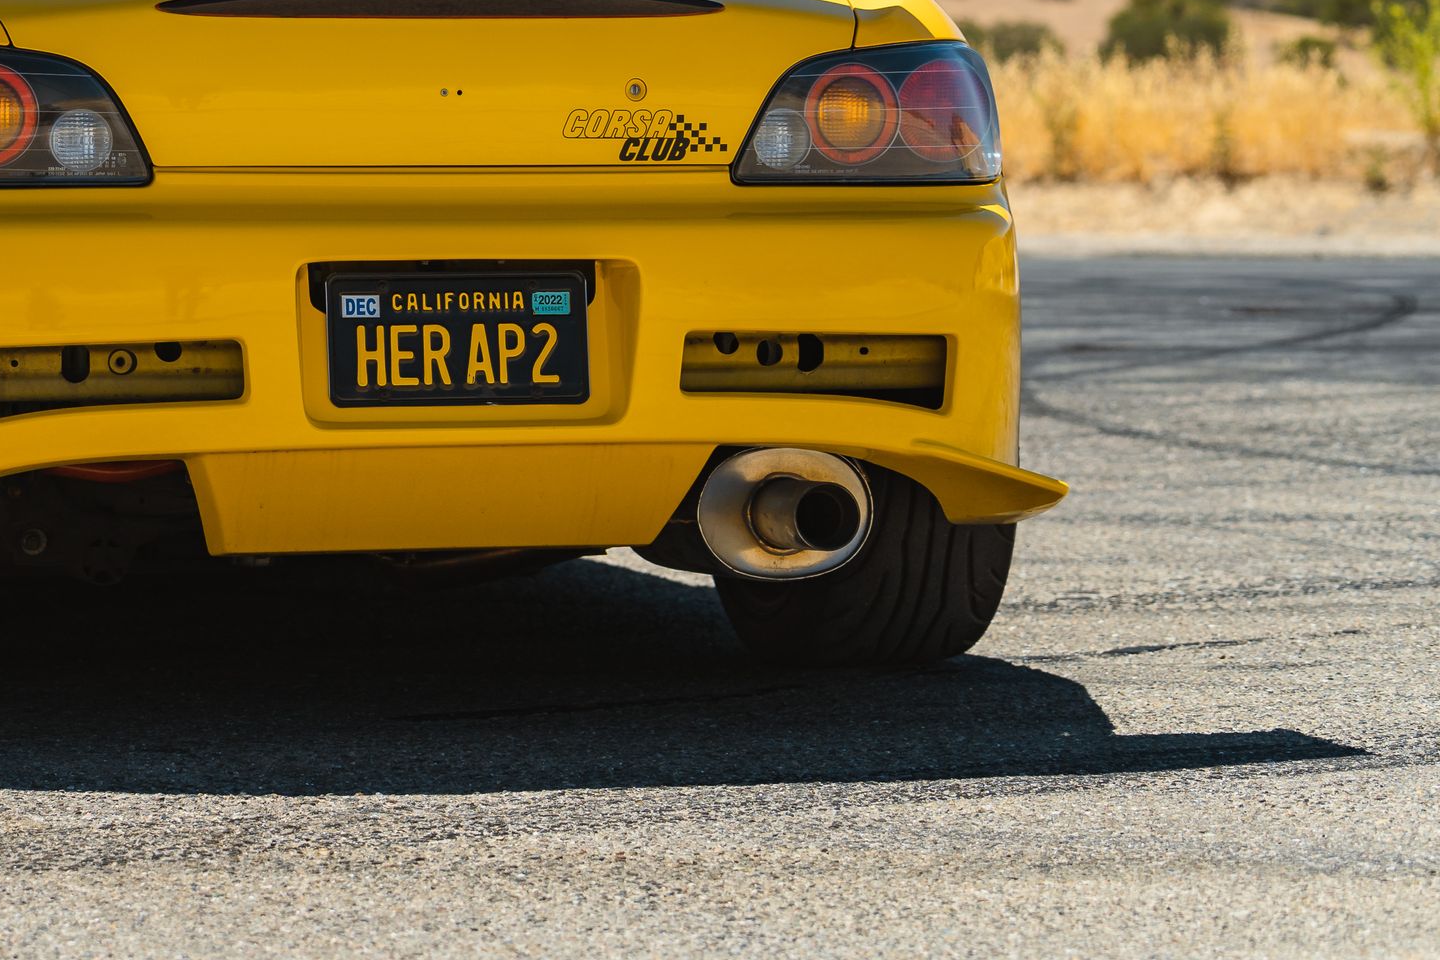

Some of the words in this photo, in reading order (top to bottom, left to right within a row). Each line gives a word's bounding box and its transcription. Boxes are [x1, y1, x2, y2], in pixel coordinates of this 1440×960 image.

[562, 109, 674, 139] CORSA
[619, 137, 691, 161] CLUB
[345, 297, 377, 316] DEC
[391, 291, 525, 312] CALIFORNIA
[538, 294, 563, 305] 2022
[356, 323, 452, 387] HER
[466, 322, 560, 385] AP2
